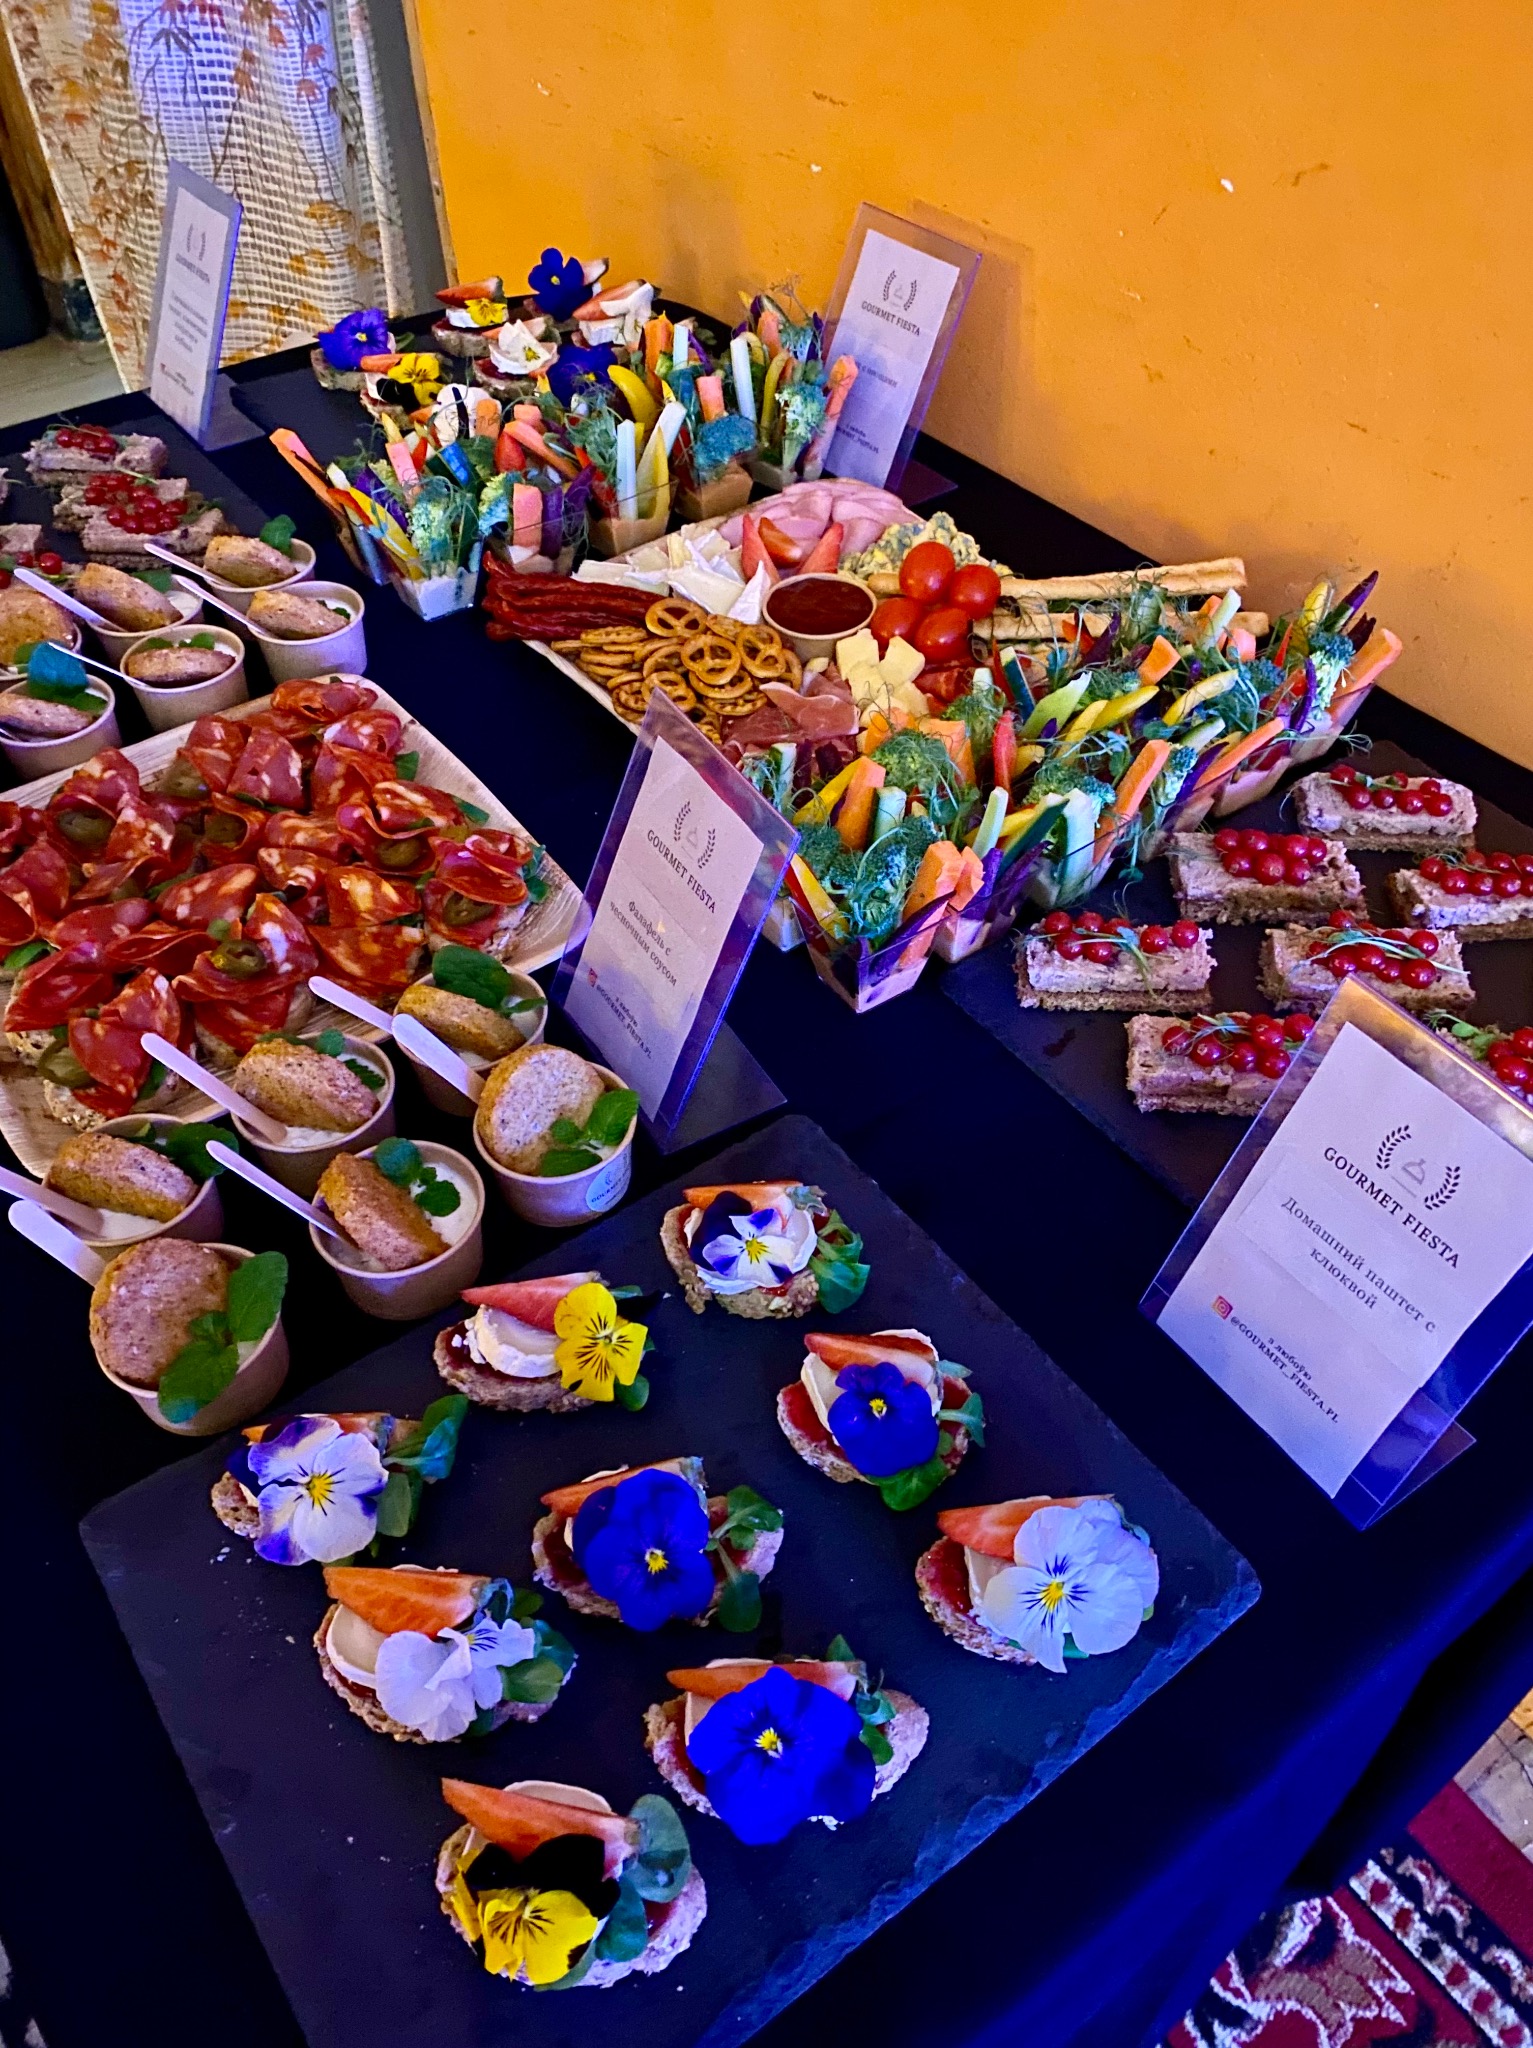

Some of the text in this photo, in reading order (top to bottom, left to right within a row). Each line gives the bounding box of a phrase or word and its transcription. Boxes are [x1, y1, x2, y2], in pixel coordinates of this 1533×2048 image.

[861, 300, 920, 336] GOURMET FIESTA
[647, 829, 715, 913] GOURMET FIESTA
[610, 901, 677, 987] чесночным соусом
[628, 900, 665, 951] Фалафель
[1323, 1147, 1459, 1269] GOURMET FIESTA
[1281, 1197, 1436, 1333] Домашний паштет с
[1309, 1248, 1378, 1310] клюквой
[1230, 1315, 1340, 1424] @GOURMET_FIESTA.PL
